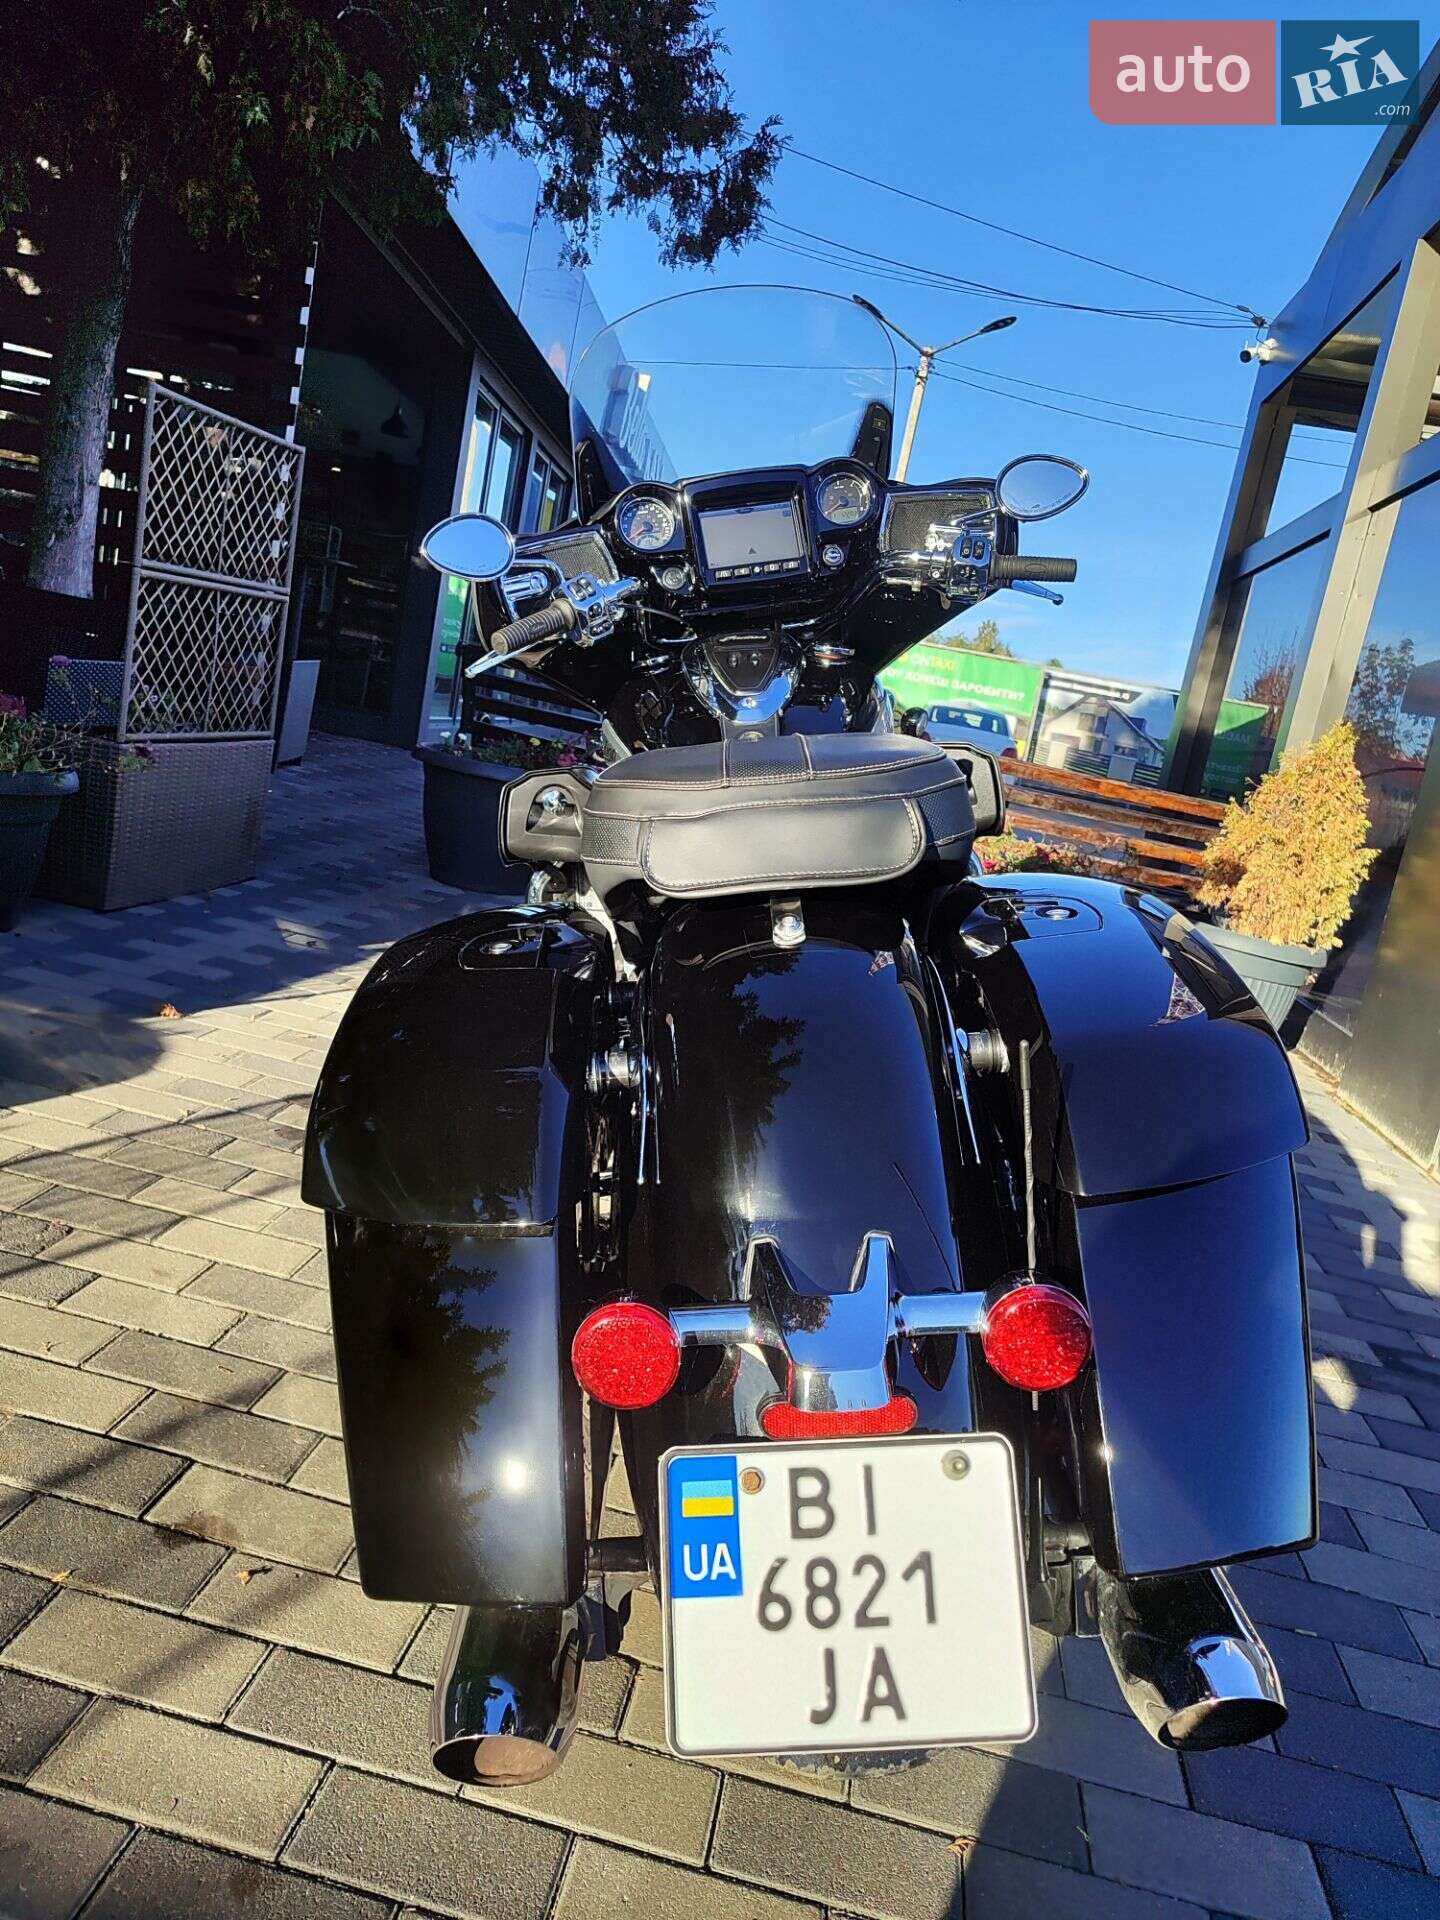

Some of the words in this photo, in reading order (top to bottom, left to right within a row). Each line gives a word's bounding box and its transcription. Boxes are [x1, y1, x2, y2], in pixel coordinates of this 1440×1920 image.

[788, 1464, 877, 1539] BI
[683, 1542, 737, 1581] UA
[757, 1551, 937, 1632] 6821
[809, 1646, 907, 1725] JA
